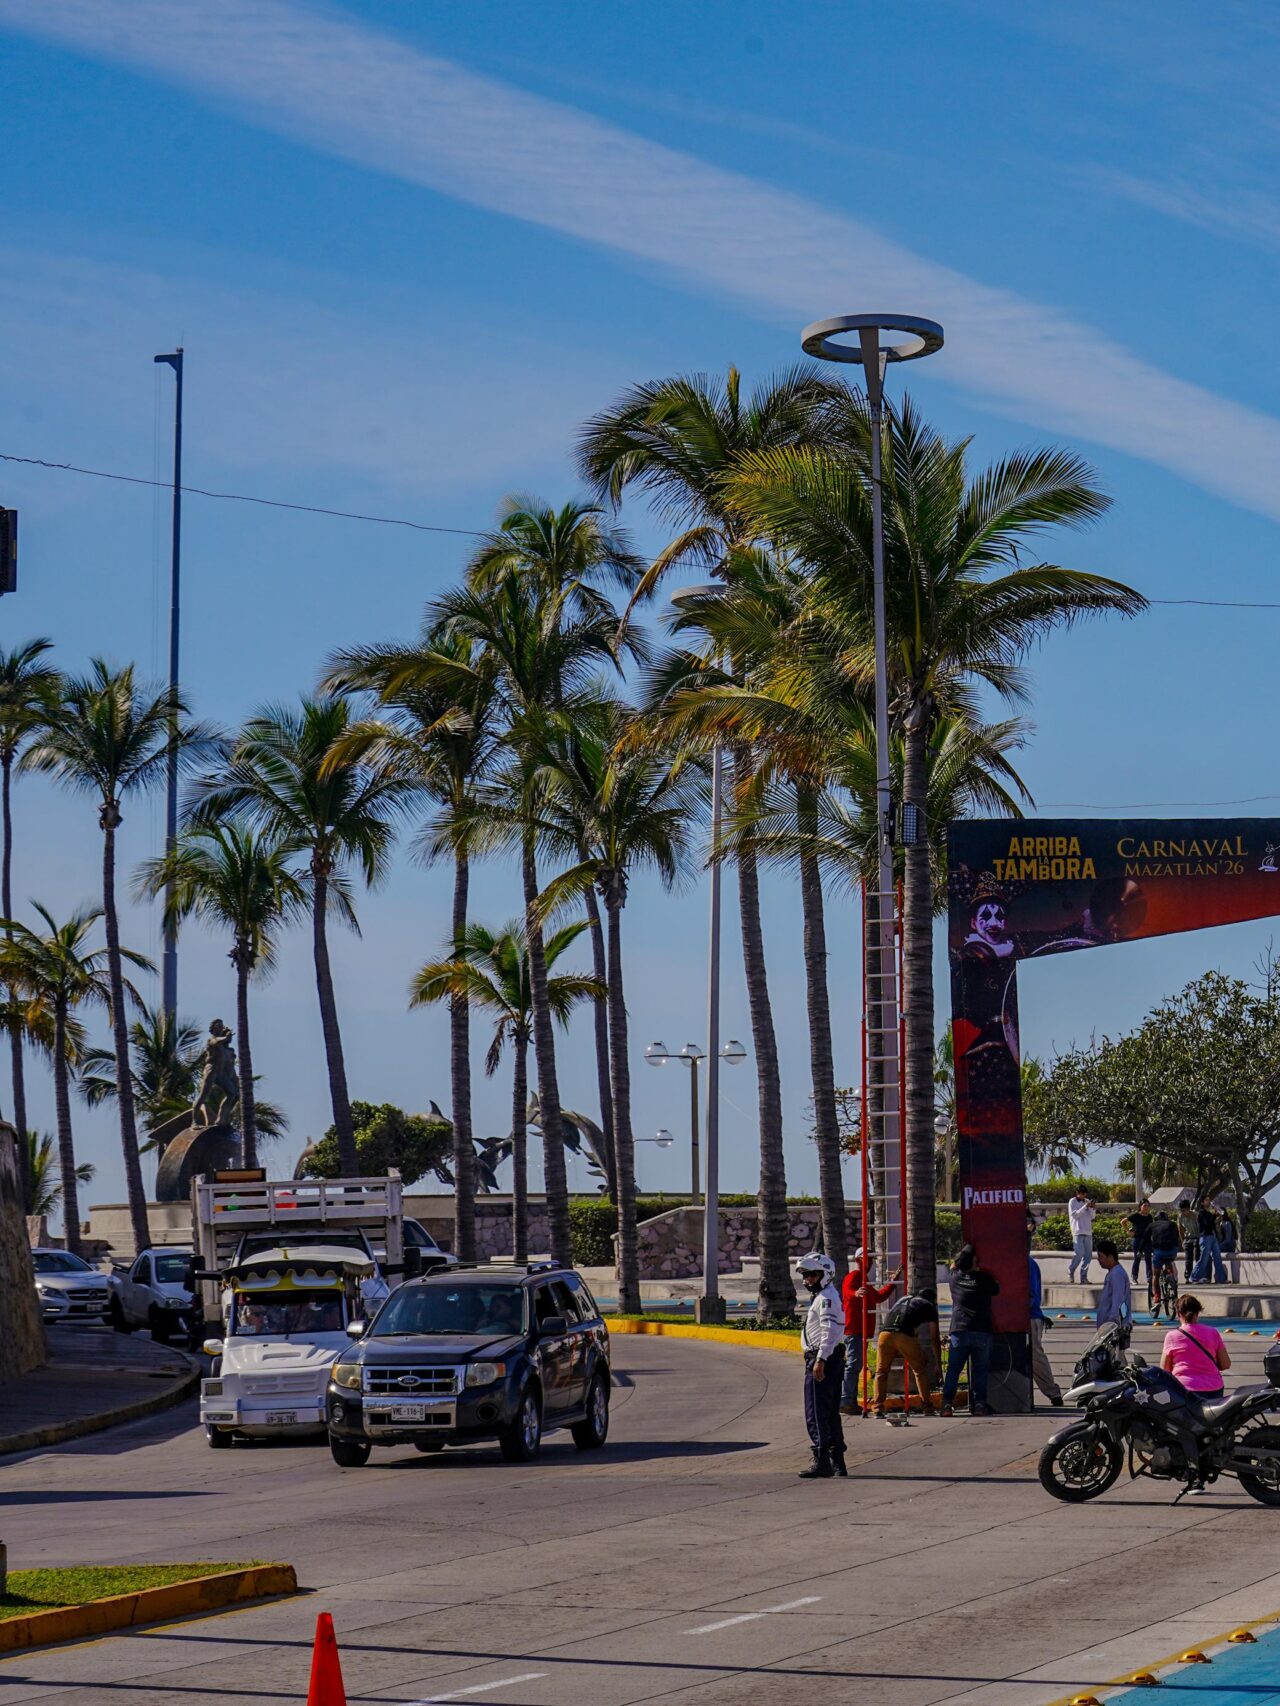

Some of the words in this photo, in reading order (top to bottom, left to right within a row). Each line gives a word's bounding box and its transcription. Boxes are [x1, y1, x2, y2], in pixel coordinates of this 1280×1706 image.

[1008, 836, 1081, 857] ARRIBA
[1116, 836, 1249, 858] CARNAVAL
[992, 857, 1096, 881] TAMBORA
[1038, 856, 1049, 865] LA
[964, 1186, 1023, 1210] PACIFICO
